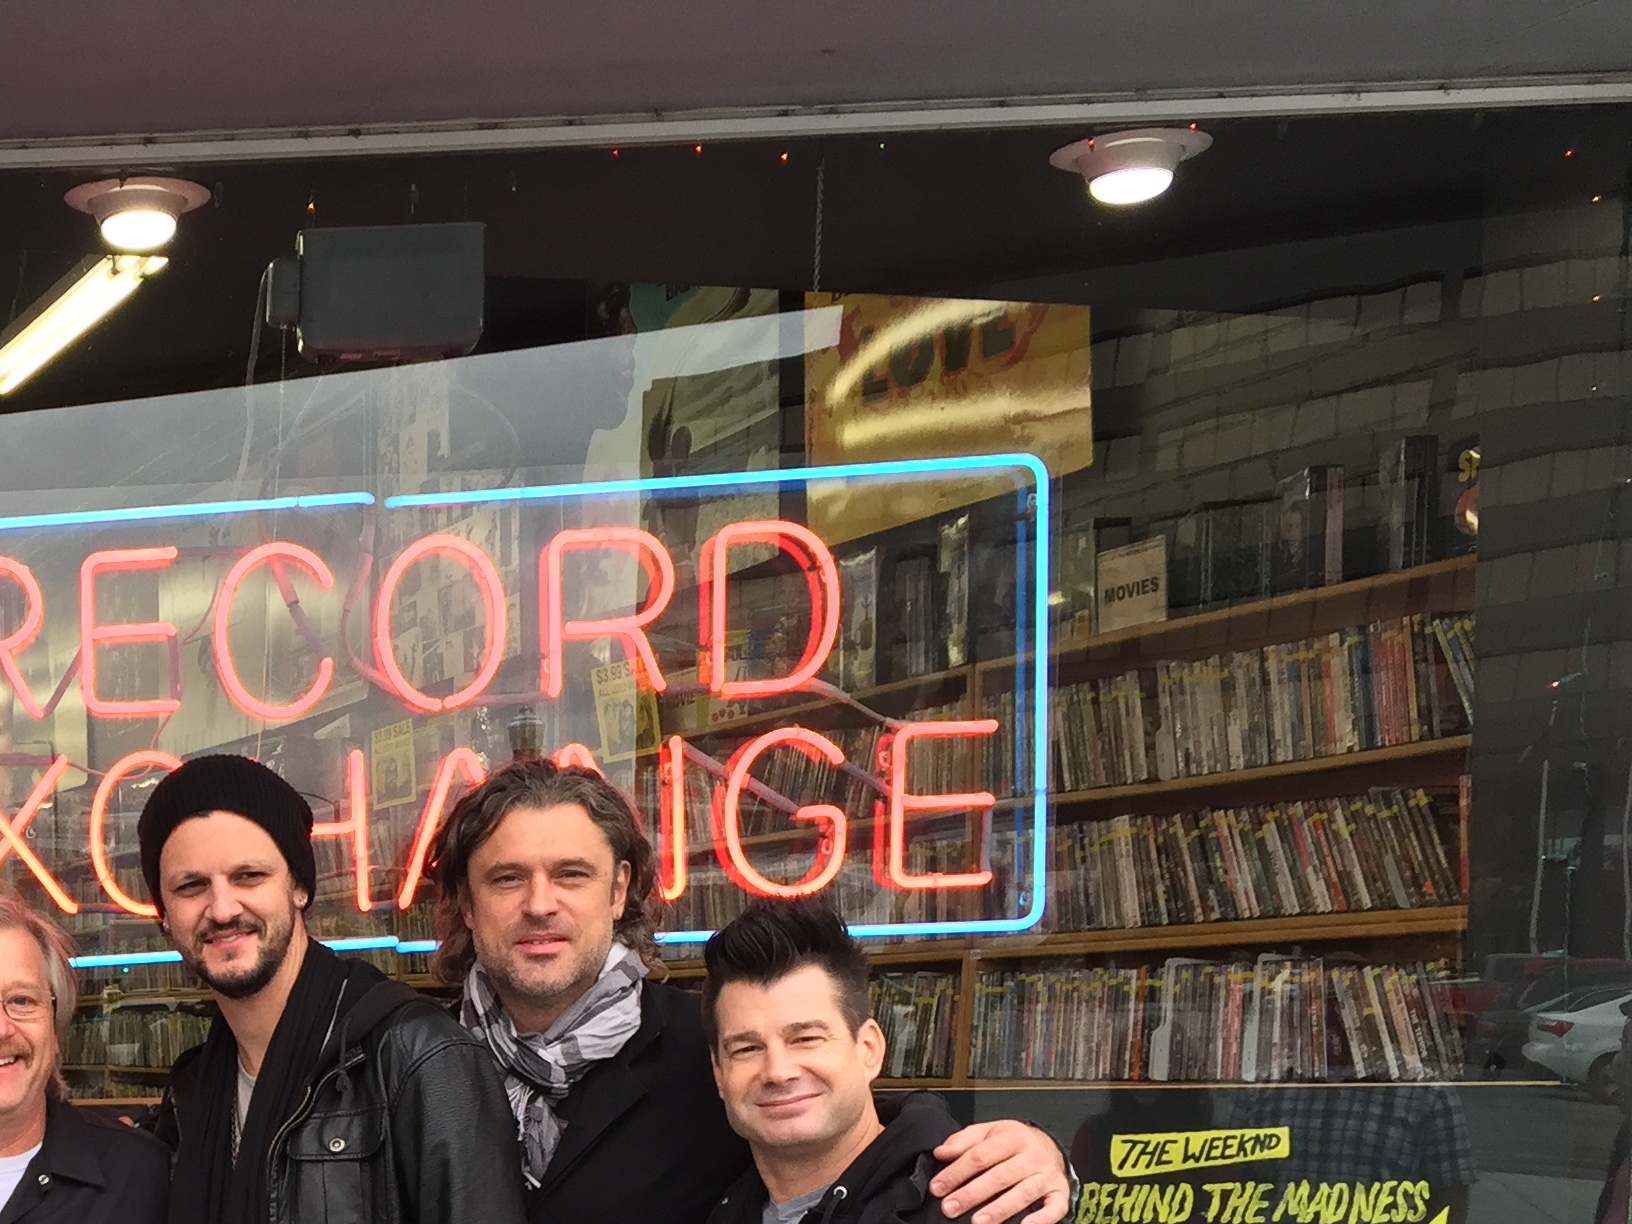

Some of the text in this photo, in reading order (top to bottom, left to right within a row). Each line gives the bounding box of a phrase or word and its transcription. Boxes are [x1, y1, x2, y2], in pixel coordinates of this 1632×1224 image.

[1104, 576, 1160, 604] MOVIES
[596, 664, 622, 686] $3.99
[1117, 1133, 1281, 1171] THE WEEKND
